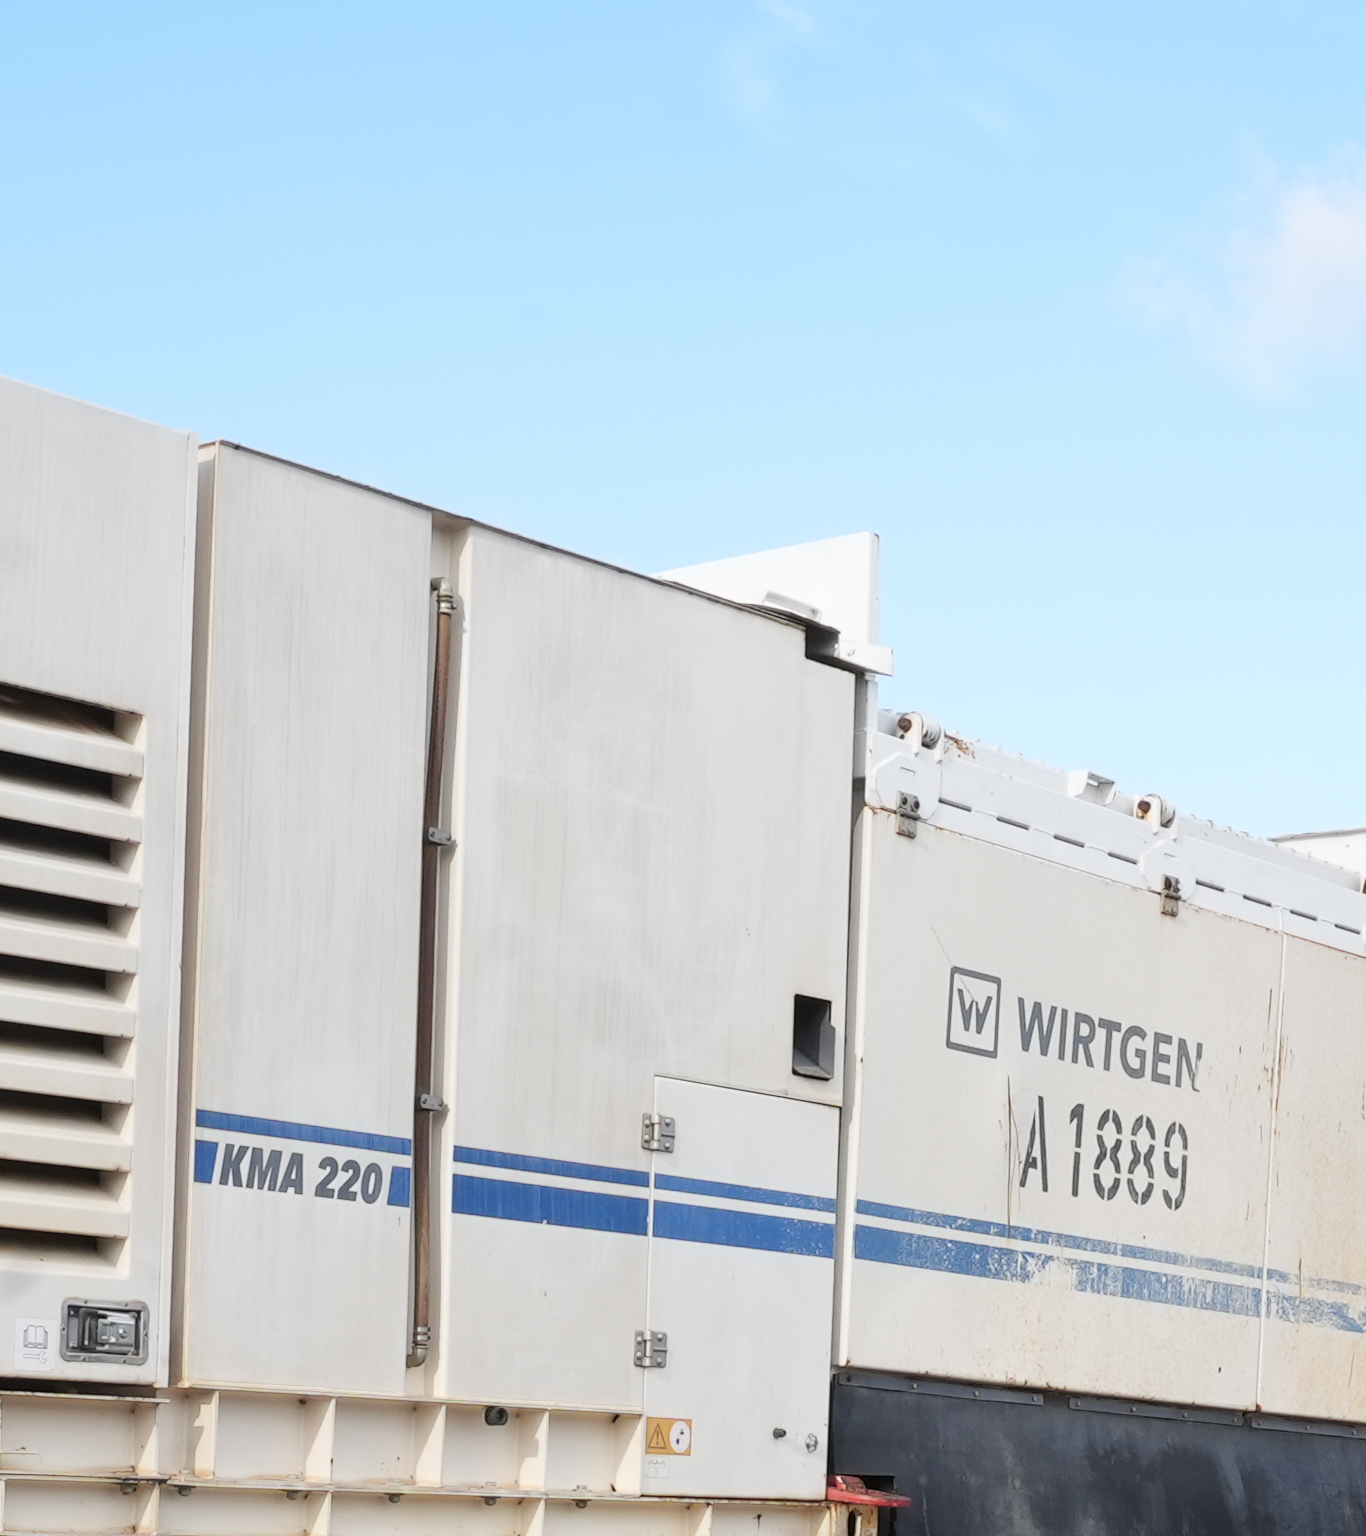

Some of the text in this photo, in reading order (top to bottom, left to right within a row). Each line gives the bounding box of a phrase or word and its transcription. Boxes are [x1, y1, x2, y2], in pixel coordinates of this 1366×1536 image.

[958, 988, 1203, 1092] W WIRTGEN
[219, 1144, 383, 1205] KMA 220
[1019, 1096, 1189, 1211] A 1889
